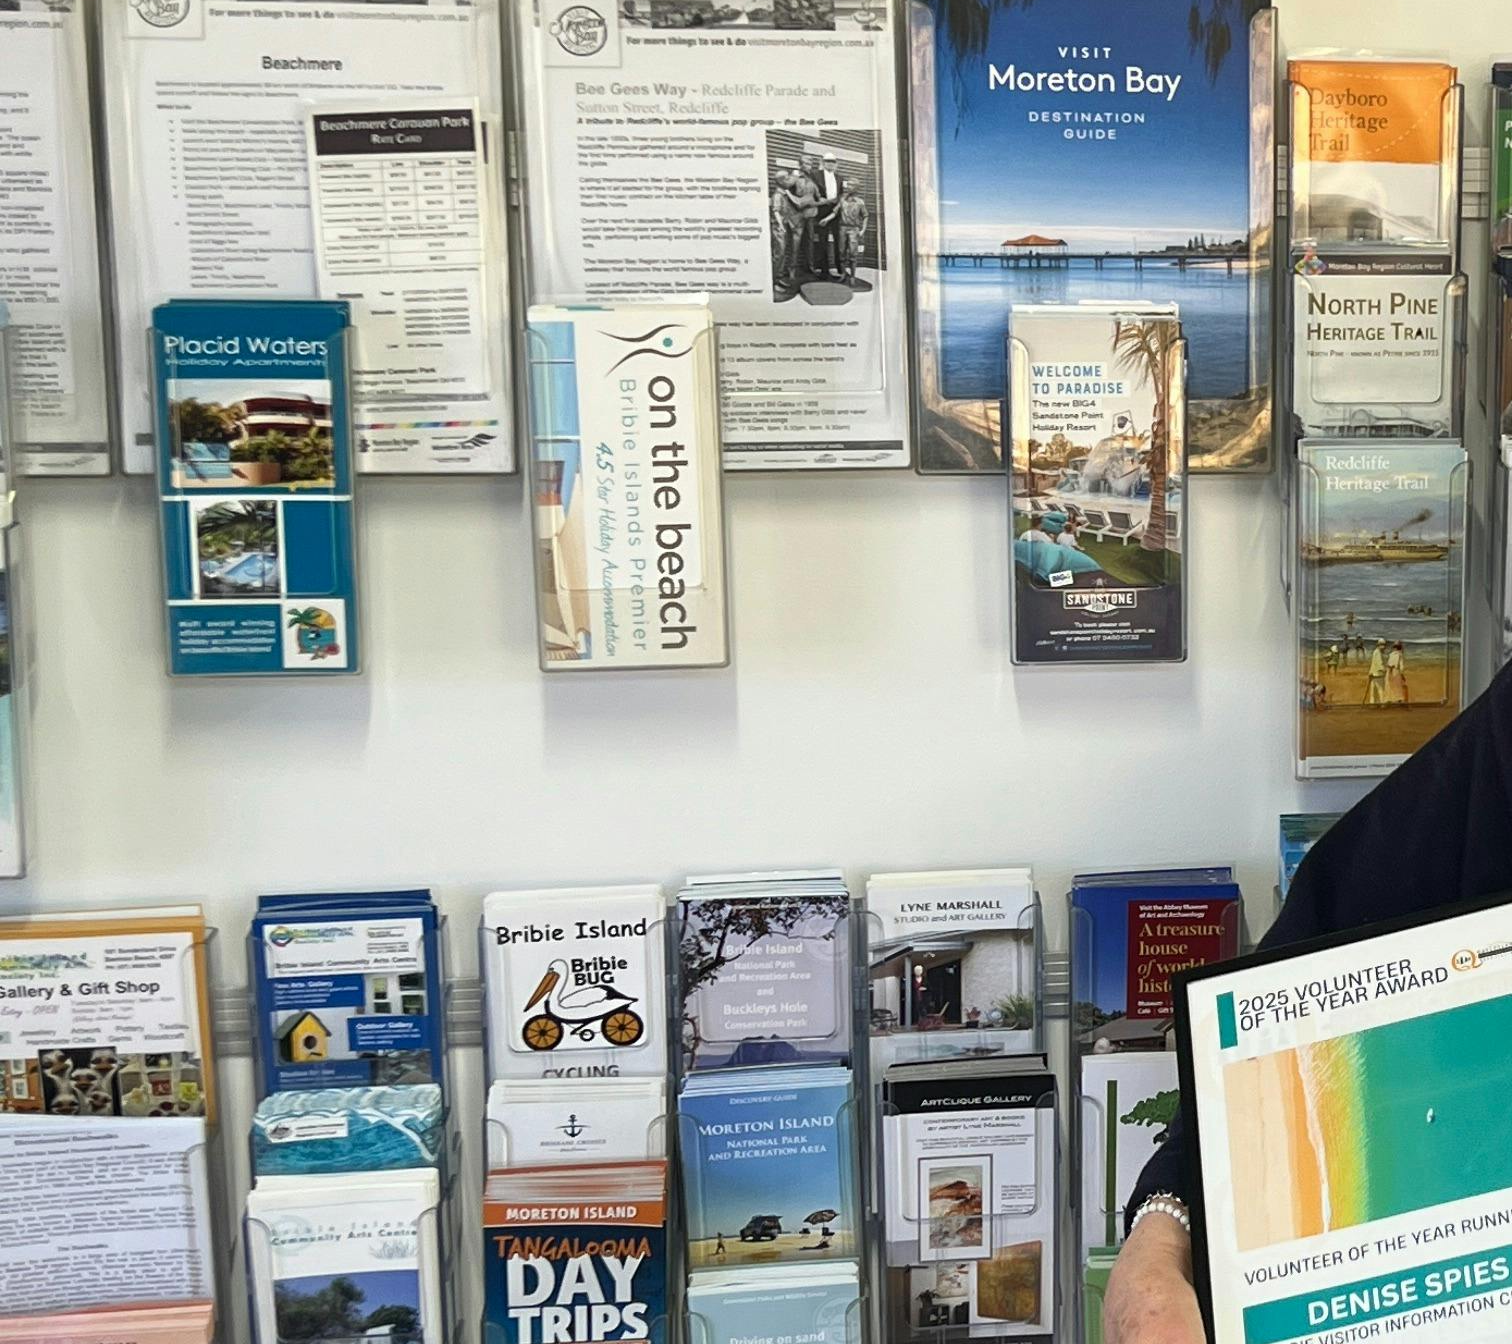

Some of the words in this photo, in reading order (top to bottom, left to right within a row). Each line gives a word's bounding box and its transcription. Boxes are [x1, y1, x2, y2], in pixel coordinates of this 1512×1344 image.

[1058, 47, 1112, 59] VISIT
[262, 56, 342, 72] Beachmere
[576, 82, 605, 95] Bee
[611, 83, 649, 95] Gees
[653, 83, 687, 98] Way
[702, 84, 761, 97] Redcliffe
[766, 86, 809, 97] Parade
[813, 85, 835, 96] and
[989, 65, 1115, 93] Moreton
[1126, 66, 1181, 100] Bay
[1310, 88, 1388, 110] Dayboro
[320, 118, 387, 131] Beachmere
[389, 118, 439, 129] Caravan
[441, 117, 470, 127] Park
[1028, 111, 1145, 123] DESTINATION
[1309, 111, 1388, 132] Heritage
[1063, 128, 1116, 139] GUIDE
[1310, 133, 1349, 151] Trail
[1308, 292, 1381, 315] NORTH
[1390, 292, 1438, 315] PINE
[1307, 322, 1385, 340] HERITAGE
[1390, 322, 1438, 340] TRAIL
[165, 336, 240, 355] Placid
[247, 337, 328, 355] Waters
[1032, 366, 1101, 377] WELCOME
[1032, 384, 1050, 395] TO
[1057, 383, 1123, 395] PARADISE
[648, 376, 677, 428] on
[1032, 424, 1064, 433] Holiday
[1325, 455, 1390, 471] Redcliffe
[650, 442, 688, 510] the
[1325, 476, 1390, 492] Heritage
[1394, 476, 1428, 490] Trail
[656, 524, 696, 650] beach
[1067, 594, 1133, 605] SANDSTONE
[900, 903, 932, 912] LYNE
[936, 900, 1003, 910] MARSHALL
[894, 916, 928, 924] STUDIO
[496, 924, 565, 945] Bribie
[575, 918, 647, 940] Island
[1139, 923, 1152, 937] A
[1156, 923, 1225, 937] treasure
[1139, 941, 1188, 956] house
[571, 957, 628, 972] Bribie
[574, 970, 614, 985] BUG
[60, 984, 72, 996] &
[78, 983, 109, 995] Gift
[115, 981, 160, 995] Shop
[1138, 980, 1172, 993] hist
[1239, 989, 1289, 1016] 2025
[1294, 958, 1412, 1001] VOLUNTEER
[1240, 1013, 1265, 1032] OF
[1274, 1001, 1311, 1024] THE
[1315, 987, 1368, 1013] YEAR
[1375, 967, 1449, 998] AWARD
[699, 1120, 774, 1136] MORETON
[779, 1115, 834, 1130] ISLAND
[506, 1207, 579, 1221] MORETON
[584, 1205, 636, 1219] ISLAND
[493, 1235, 652, 1259] TANGALOOMA
[1245, 1250, 1343, 1286] VOLUNTEER
[1349, 1244, 1369, 1261] OF
[1376, 1234, 1407, 1254] THE
[1410, 1223, 1456, 1245] YEAR
[507, 1252, 646, 1307] DAY
[1308, 1278, 1419, 1327] DENISE
[1425, 1257, 1510, 1297] SPIES
[1385, 1298, 1495, 1333] INFORMATION
[776, 1335, 792, 1344] on
[795, 1332, 825, 1343] sand
